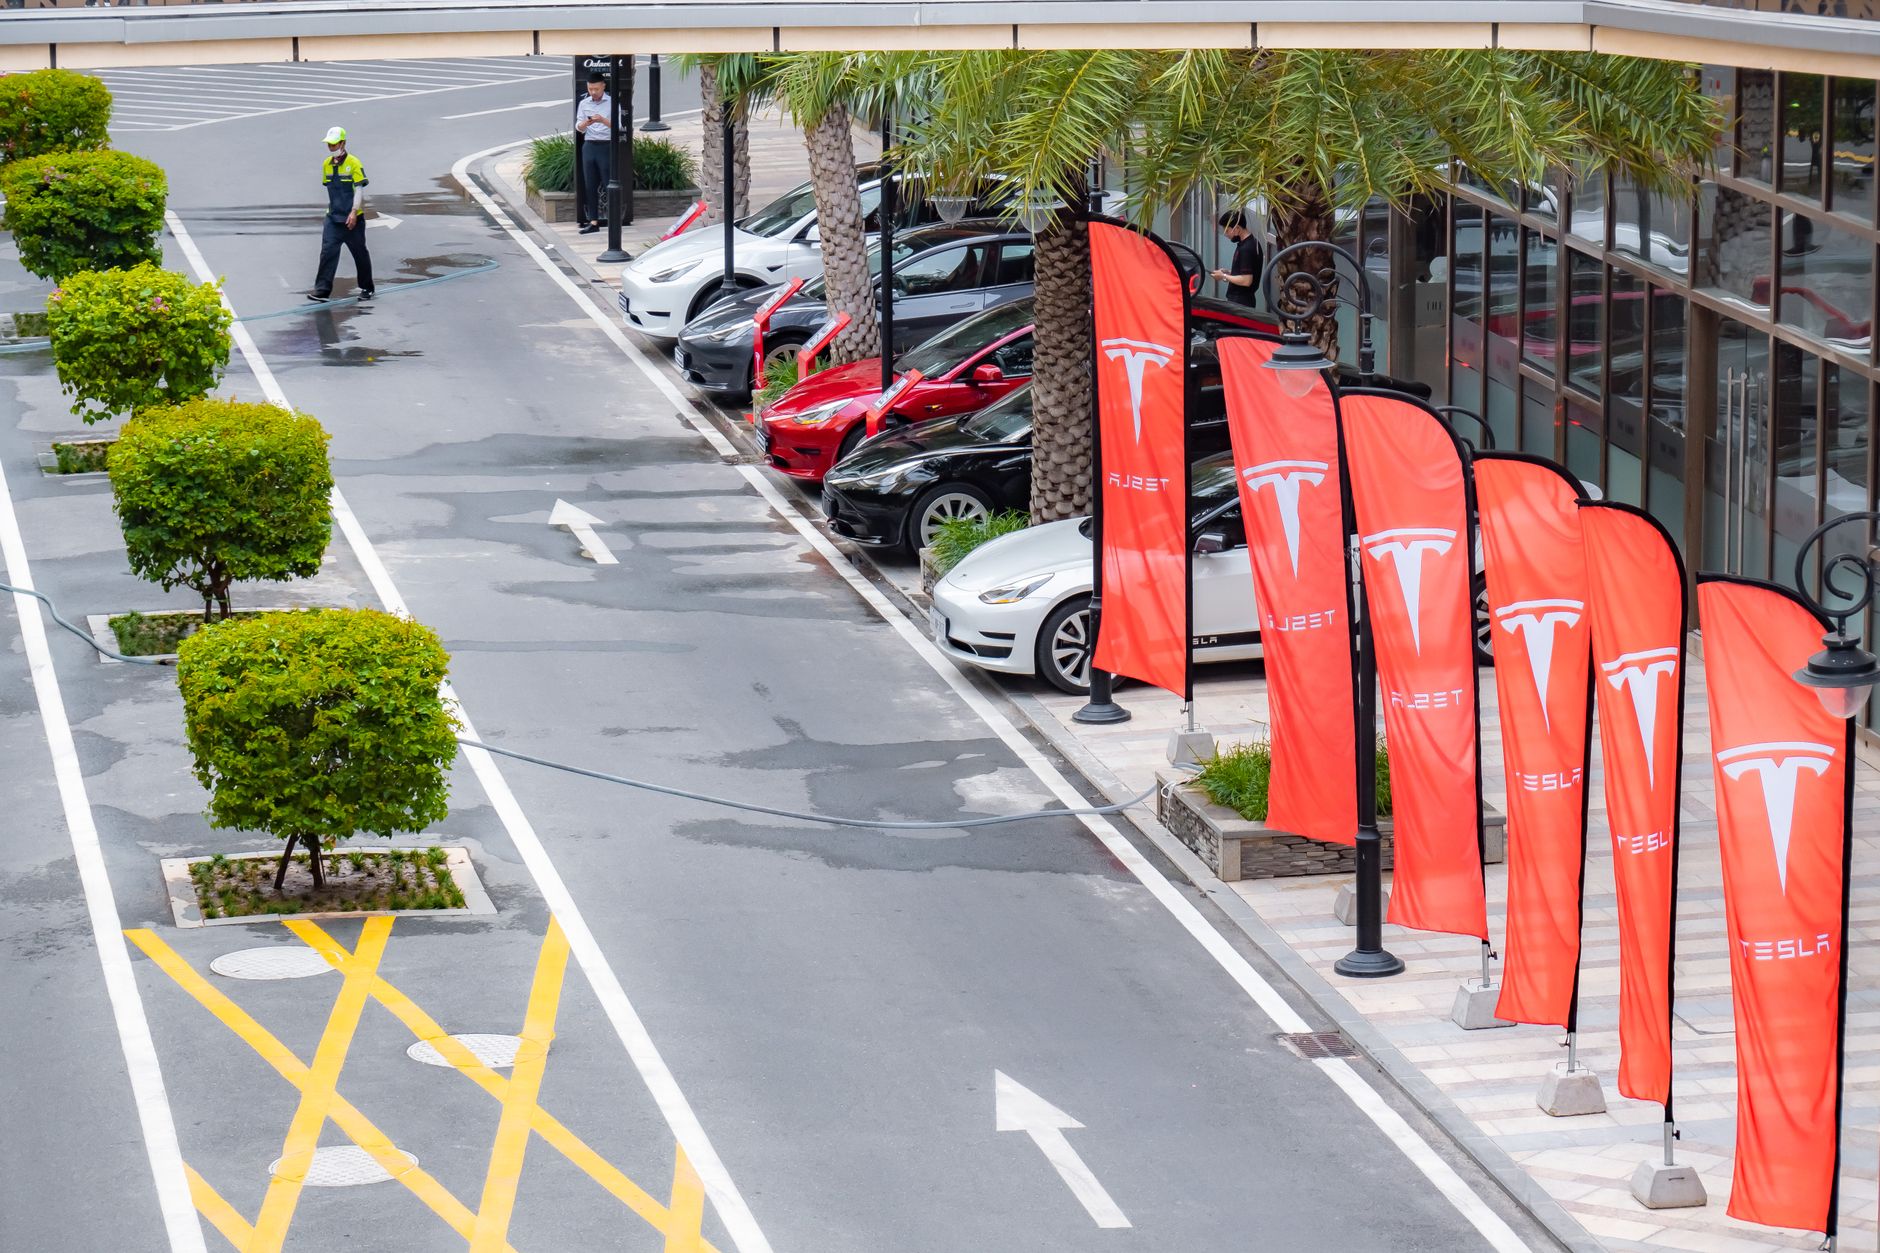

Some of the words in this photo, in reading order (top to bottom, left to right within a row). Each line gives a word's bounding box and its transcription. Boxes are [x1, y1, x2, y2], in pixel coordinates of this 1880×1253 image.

[1193, 637, 1217, 645] SLA
[1516, 768, 1581, 791] ESLA
[1617, 825, 1671, 854] TESL
[1740, 934, 1829, 960] TESLA
